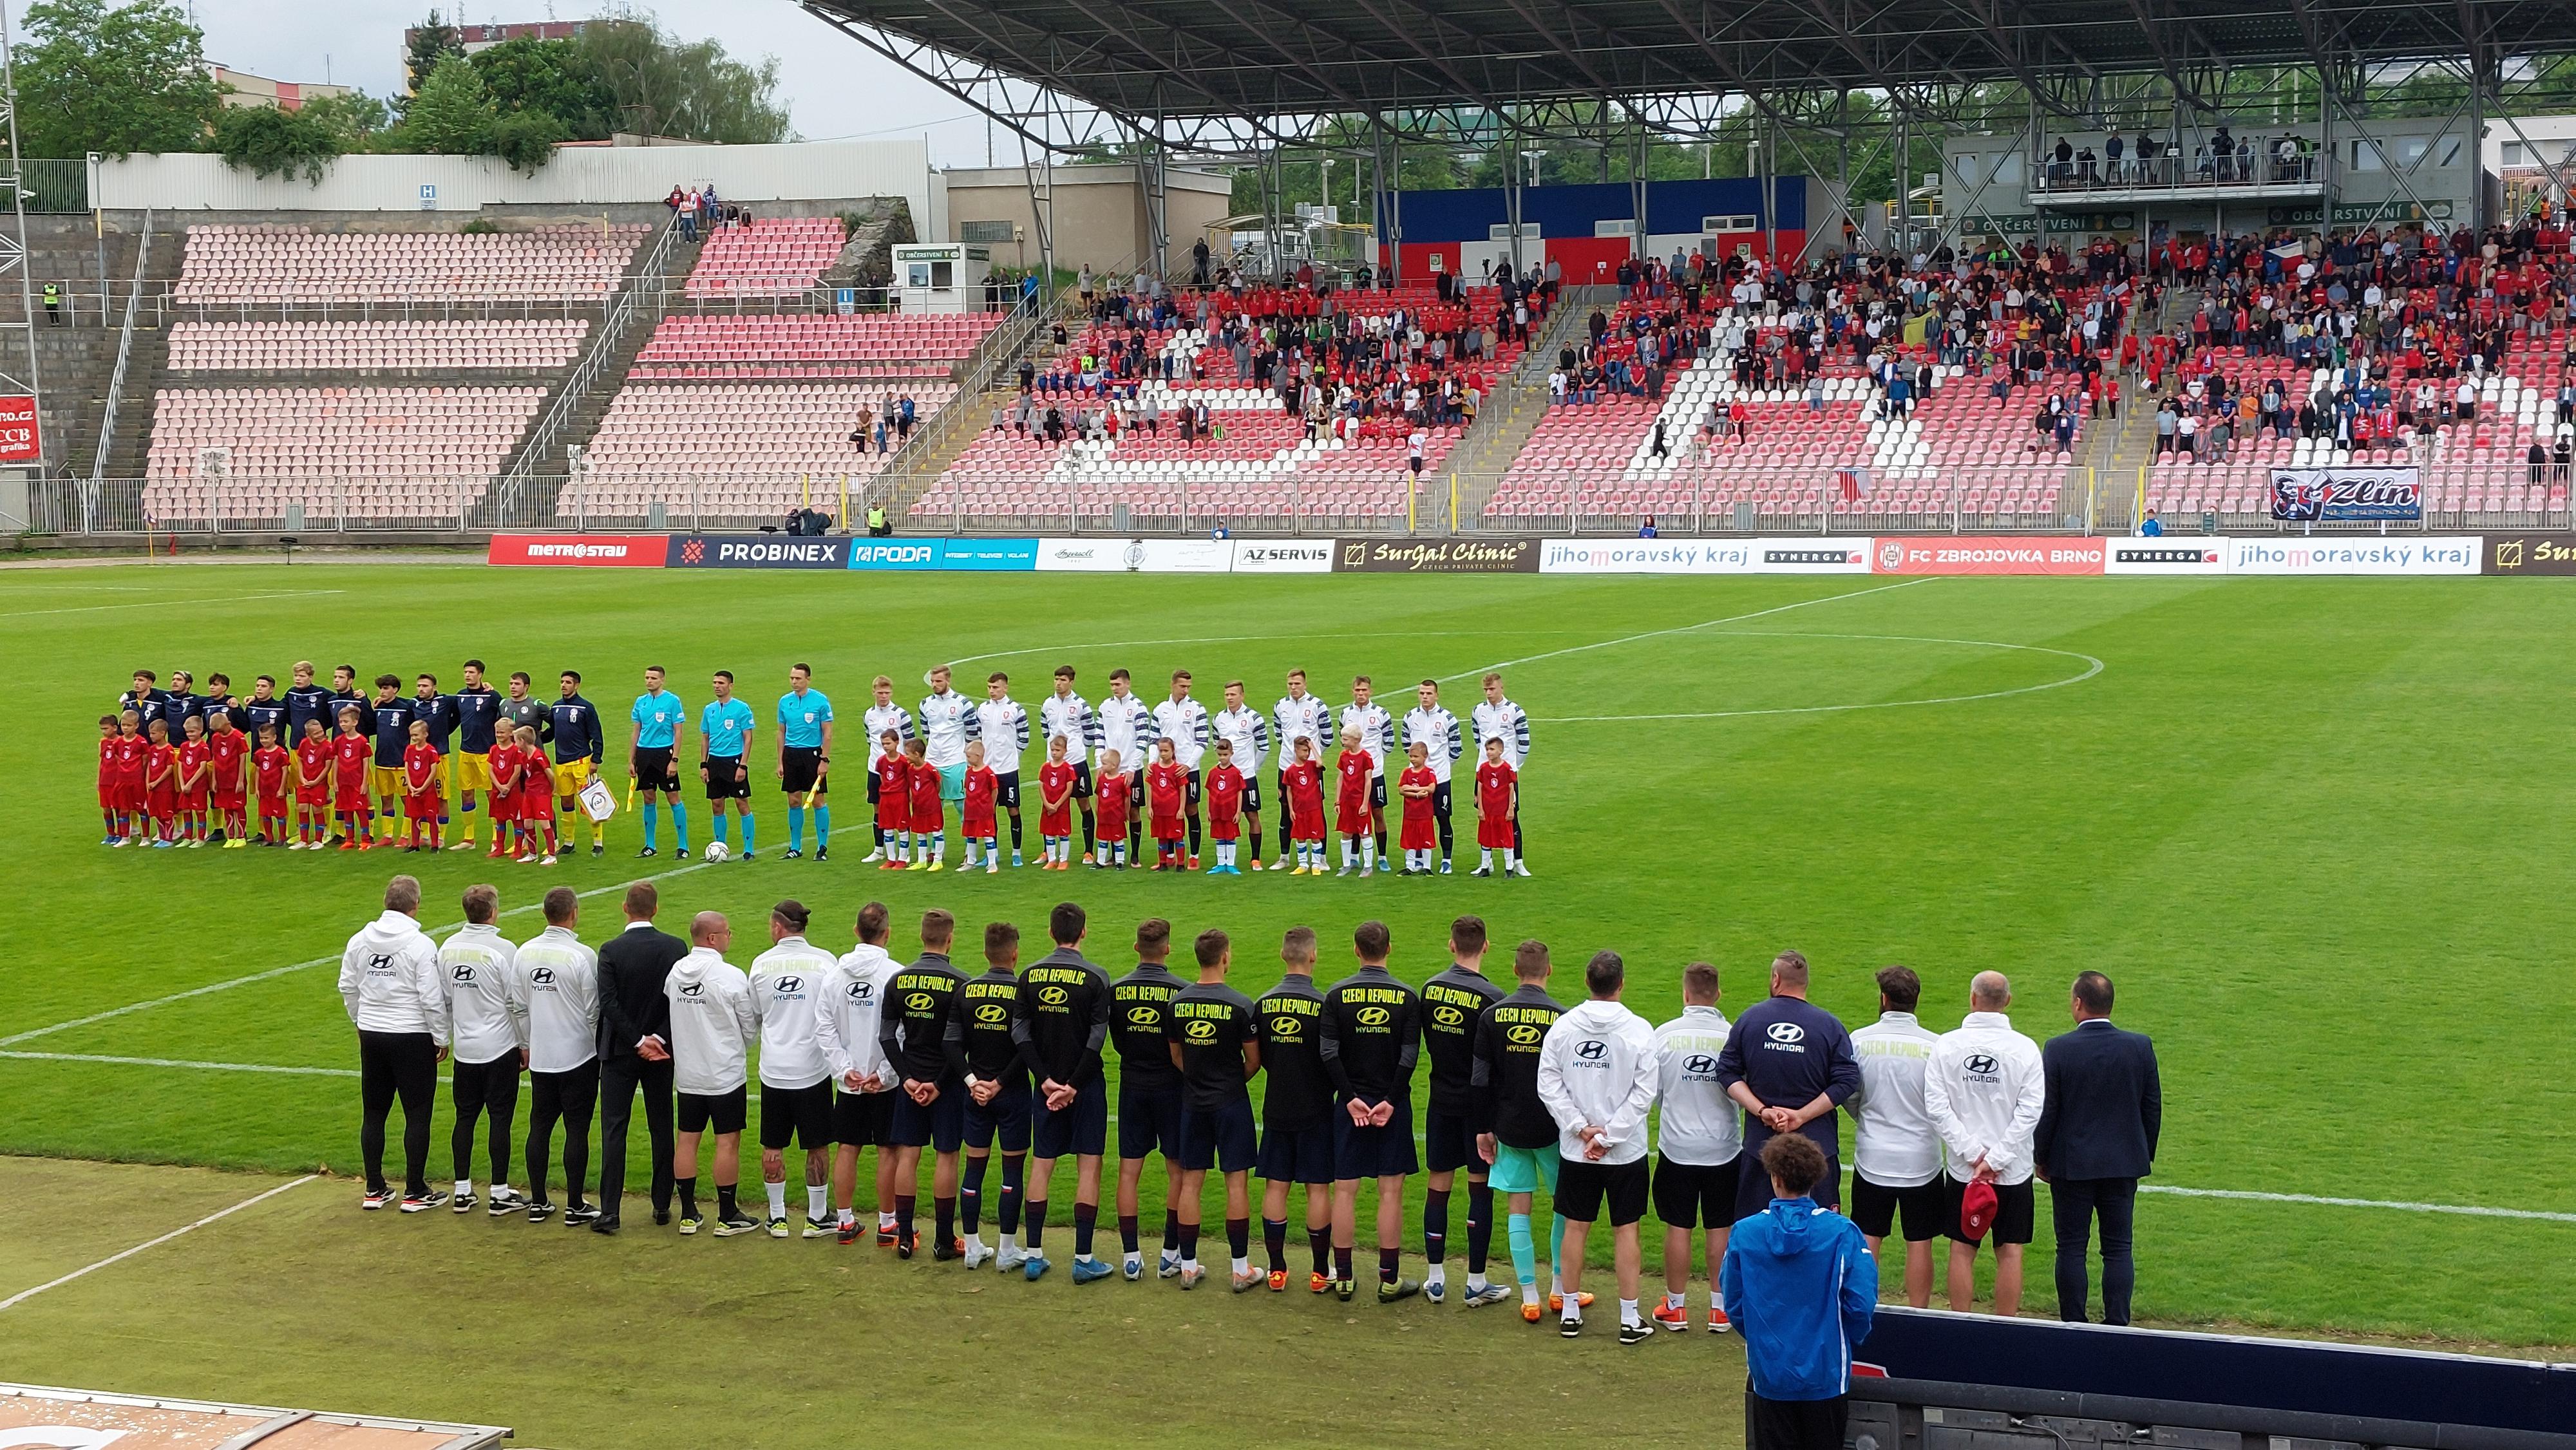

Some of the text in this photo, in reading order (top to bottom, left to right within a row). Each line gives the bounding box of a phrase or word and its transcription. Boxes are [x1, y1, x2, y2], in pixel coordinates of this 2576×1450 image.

[423, 186, 433, 197] H
[2293, 204, 2403, 221] OBČRSTVNÍ
[1813, 260, 1821, 268] K
[1344, 274, 1350, 282] J
[2325, 478, 2415, 505] Zlín
[719, 543, 838, 562] PROBINEX
[872, 546, 932, 563] PODA
[1244, 549, 1328, 560] AZ SERVIS
[1548, 546, 1748, 567] jihomoravský kraj
[1768, 552, 1842, 561] SYNERGA
[1909, 549, 2101, 563] FC ZBROJOVKA BRNO
[2120, 552, 2196, 560] SYNERGA
[2238, 545, 2470, 567] jihomoravský kraj
[144, 710, 151, 720] 9
[1079, 777, 1085, 789] 4
[1008, 787, 1014, 798] 5
[1028, 968, 1086, 985] CZECH REPUBLIC
[896, 975, 954, 992] CZECH REPUBLIC
[965, 984, 1016, 1000] CZECH REPUBL
[1115, 986, 1136, 1001] CZECH
[1341, 988, 1405, 1004] CZECH REPUBLIC
[1425, 986, 1481, 1010] CZECH REPUBLIC
[1038, 1004, 1069, 1014] HYUNDAI
[1174, 1003, 1232, 1020] CZECH REPUBLIC
[1262, 998, 1321, 1017] CZECH REPUBLIC
[905, 1011, 934, 1019] HYUNDAI
[1495, 1008, 1519, 1023] CZECH
[1127, 1025, 1161, 1033] HYUNDAI
[1432, 1022, 1464, 1035] HYUNDAI
[1185, 1037, 1217, 1046] HYUNDAI
[1271, 1035, 1303, 1044] HYUNDAI
[1696, 1035, 1725, 1052] REPUB
[1764, 1041, 1804, 1053] HYUNDAI
[1861, 1040, 1886, 1055] CZECH
[1573, 1060, 1609, 1069] HYUNDAI
[1962, 1075, 2000, 1084] HYUNDAI
